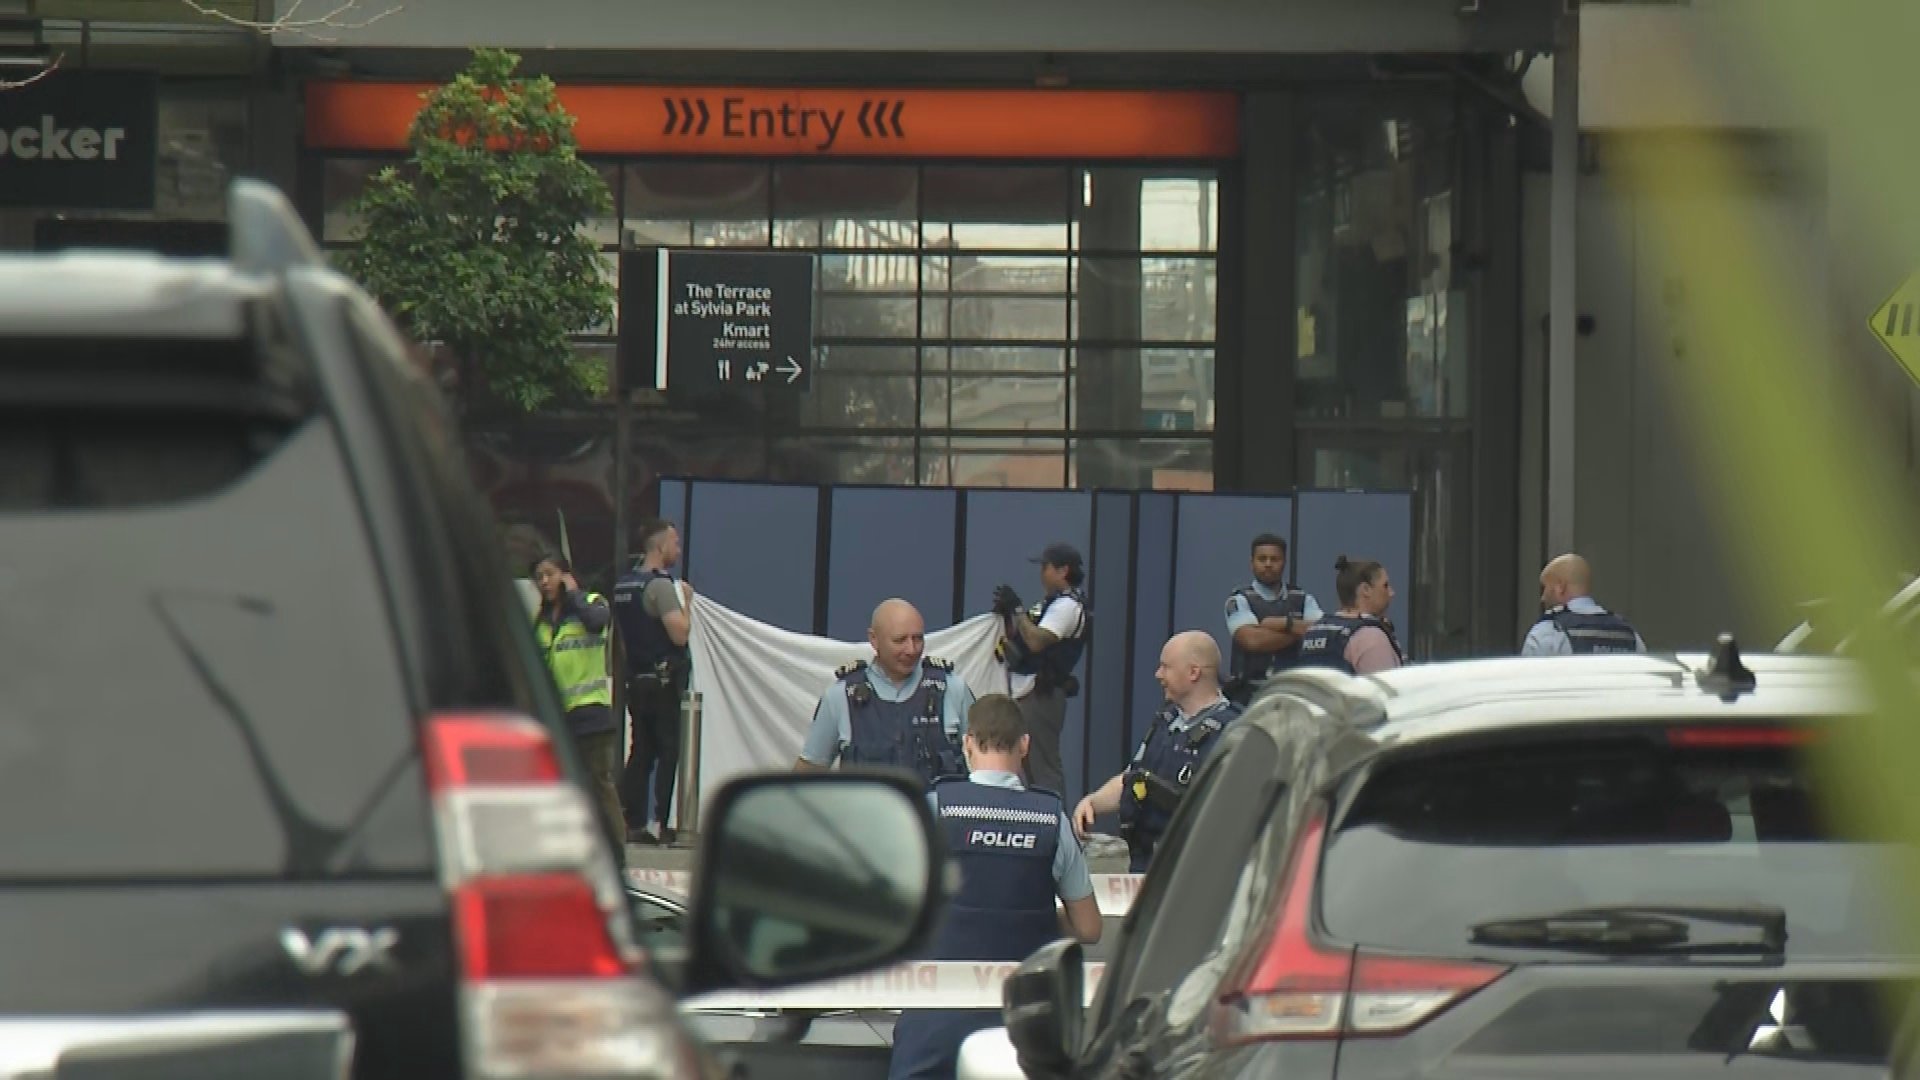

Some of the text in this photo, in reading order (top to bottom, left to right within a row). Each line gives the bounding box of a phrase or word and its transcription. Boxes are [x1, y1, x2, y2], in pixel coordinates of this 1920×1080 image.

[723, 98, 844, 150] Entry
[686, 283, 772, 300] The Terrace
[674, 300, 771, 318] at Sylvia Park
[723, 322, 770, 337] Kmart
[970, 830, 1036, 849] POLICE
[280, 926, 399, 976] VX
